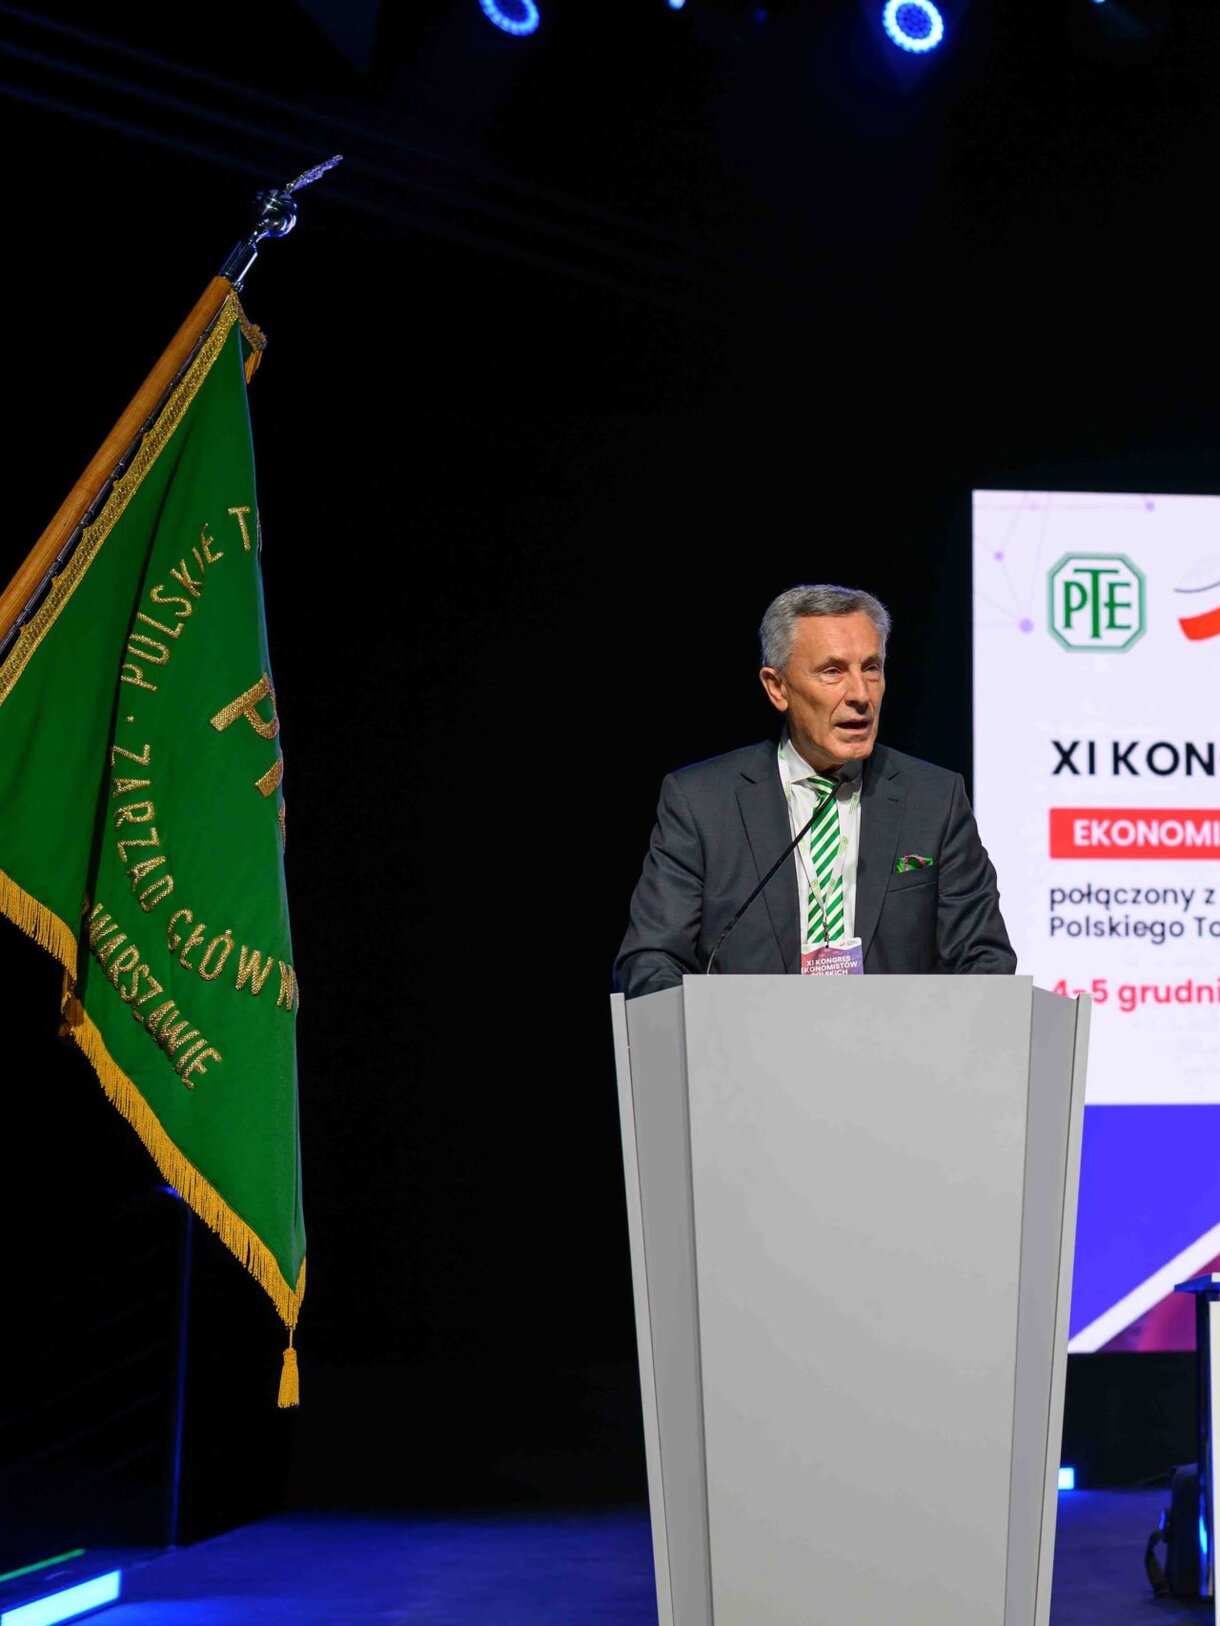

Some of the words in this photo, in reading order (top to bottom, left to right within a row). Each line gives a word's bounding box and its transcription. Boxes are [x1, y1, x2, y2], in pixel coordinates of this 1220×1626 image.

[1063, 567, 1131, 638] PTE
[1052, 741, 1095, 775] XI
[1050, 883, 1195, 912] połączony
[1204, 888, 1215, 905] z
[1050, 915, 1185, 945] Polskiego
[815, 955, 851, 965] KONGRES
